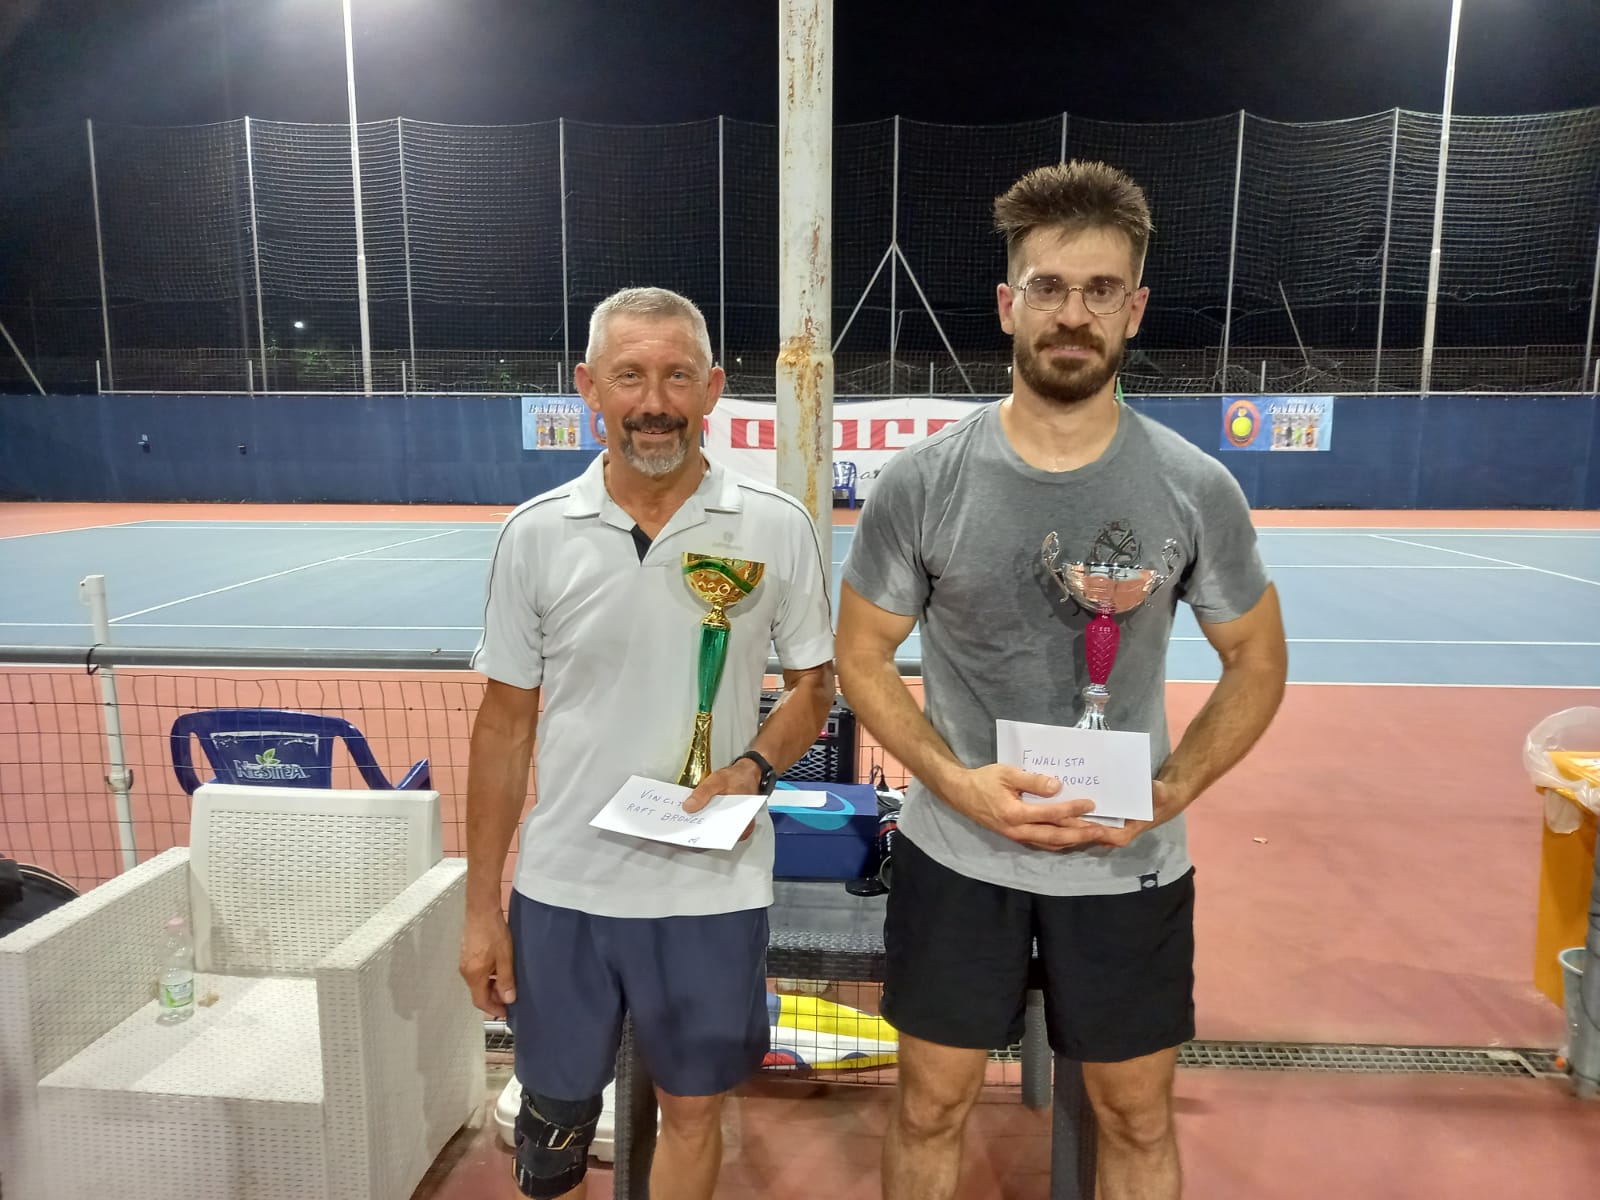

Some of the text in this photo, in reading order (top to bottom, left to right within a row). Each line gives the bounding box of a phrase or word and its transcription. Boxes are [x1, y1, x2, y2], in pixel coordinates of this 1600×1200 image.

[1022, 750, 1085, 767] FINALISTA
[640, 789, 683, 807] VINCIT
[660, 812, 705, 825] BRONZE
